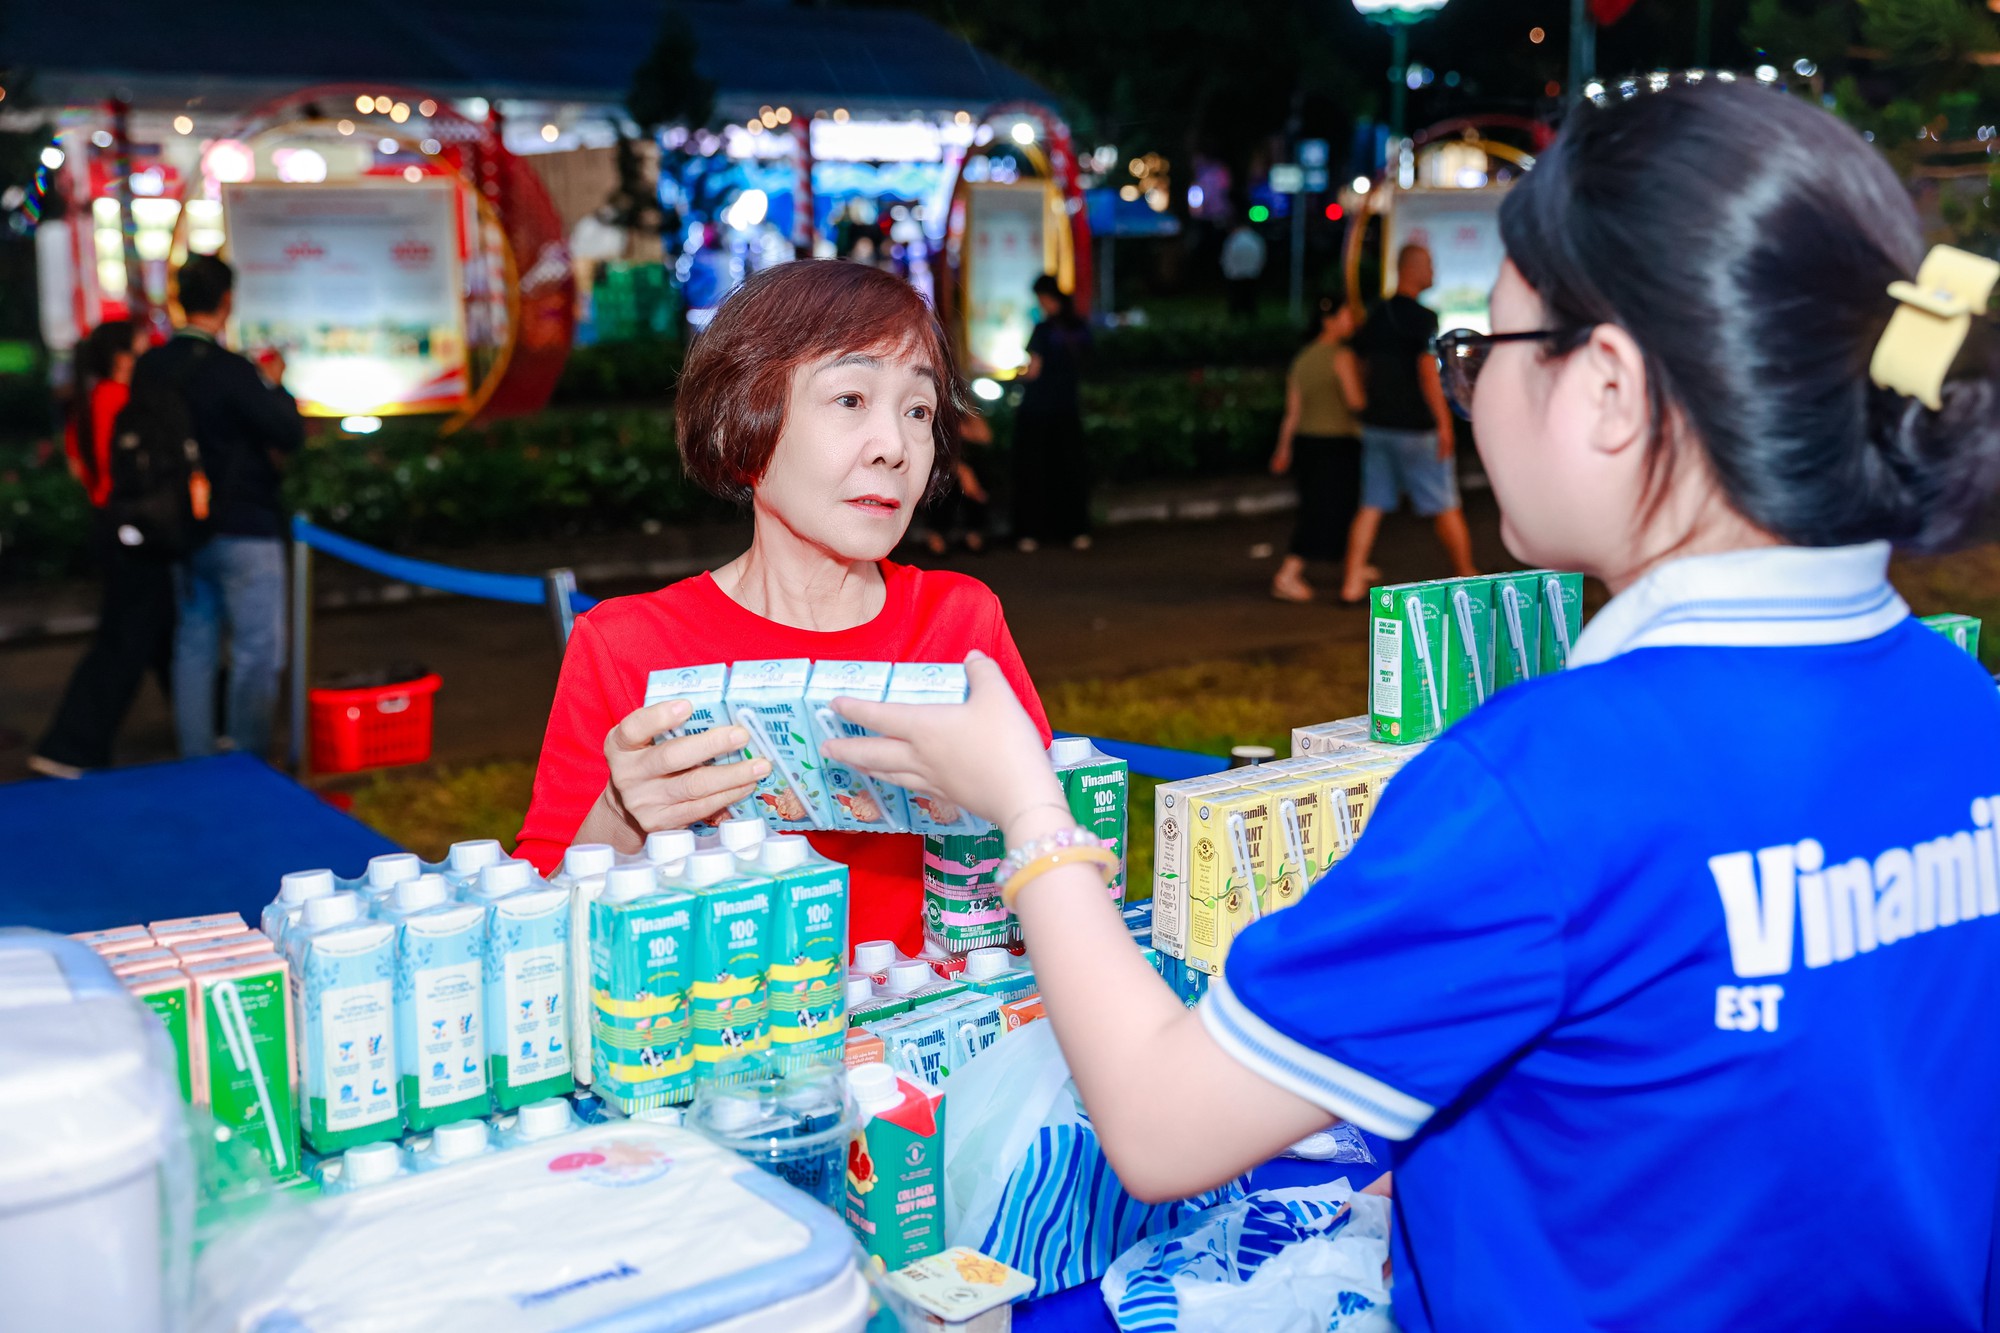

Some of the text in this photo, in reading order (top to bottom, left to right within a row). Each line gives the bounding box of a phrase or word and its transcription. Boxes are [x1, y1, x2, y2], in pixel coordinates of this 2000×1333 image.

[1081, 770, 1124, 788] Vinamilk
[791, 879, 843, 902] Vinamilk
[713, 893, 769, 918] Vinamilk
[630, 909, 690, 935] Vinamilk
[1715, 984, 1784, 1032] EST
[897, 1183, 935, 1203] COLLAGEN
